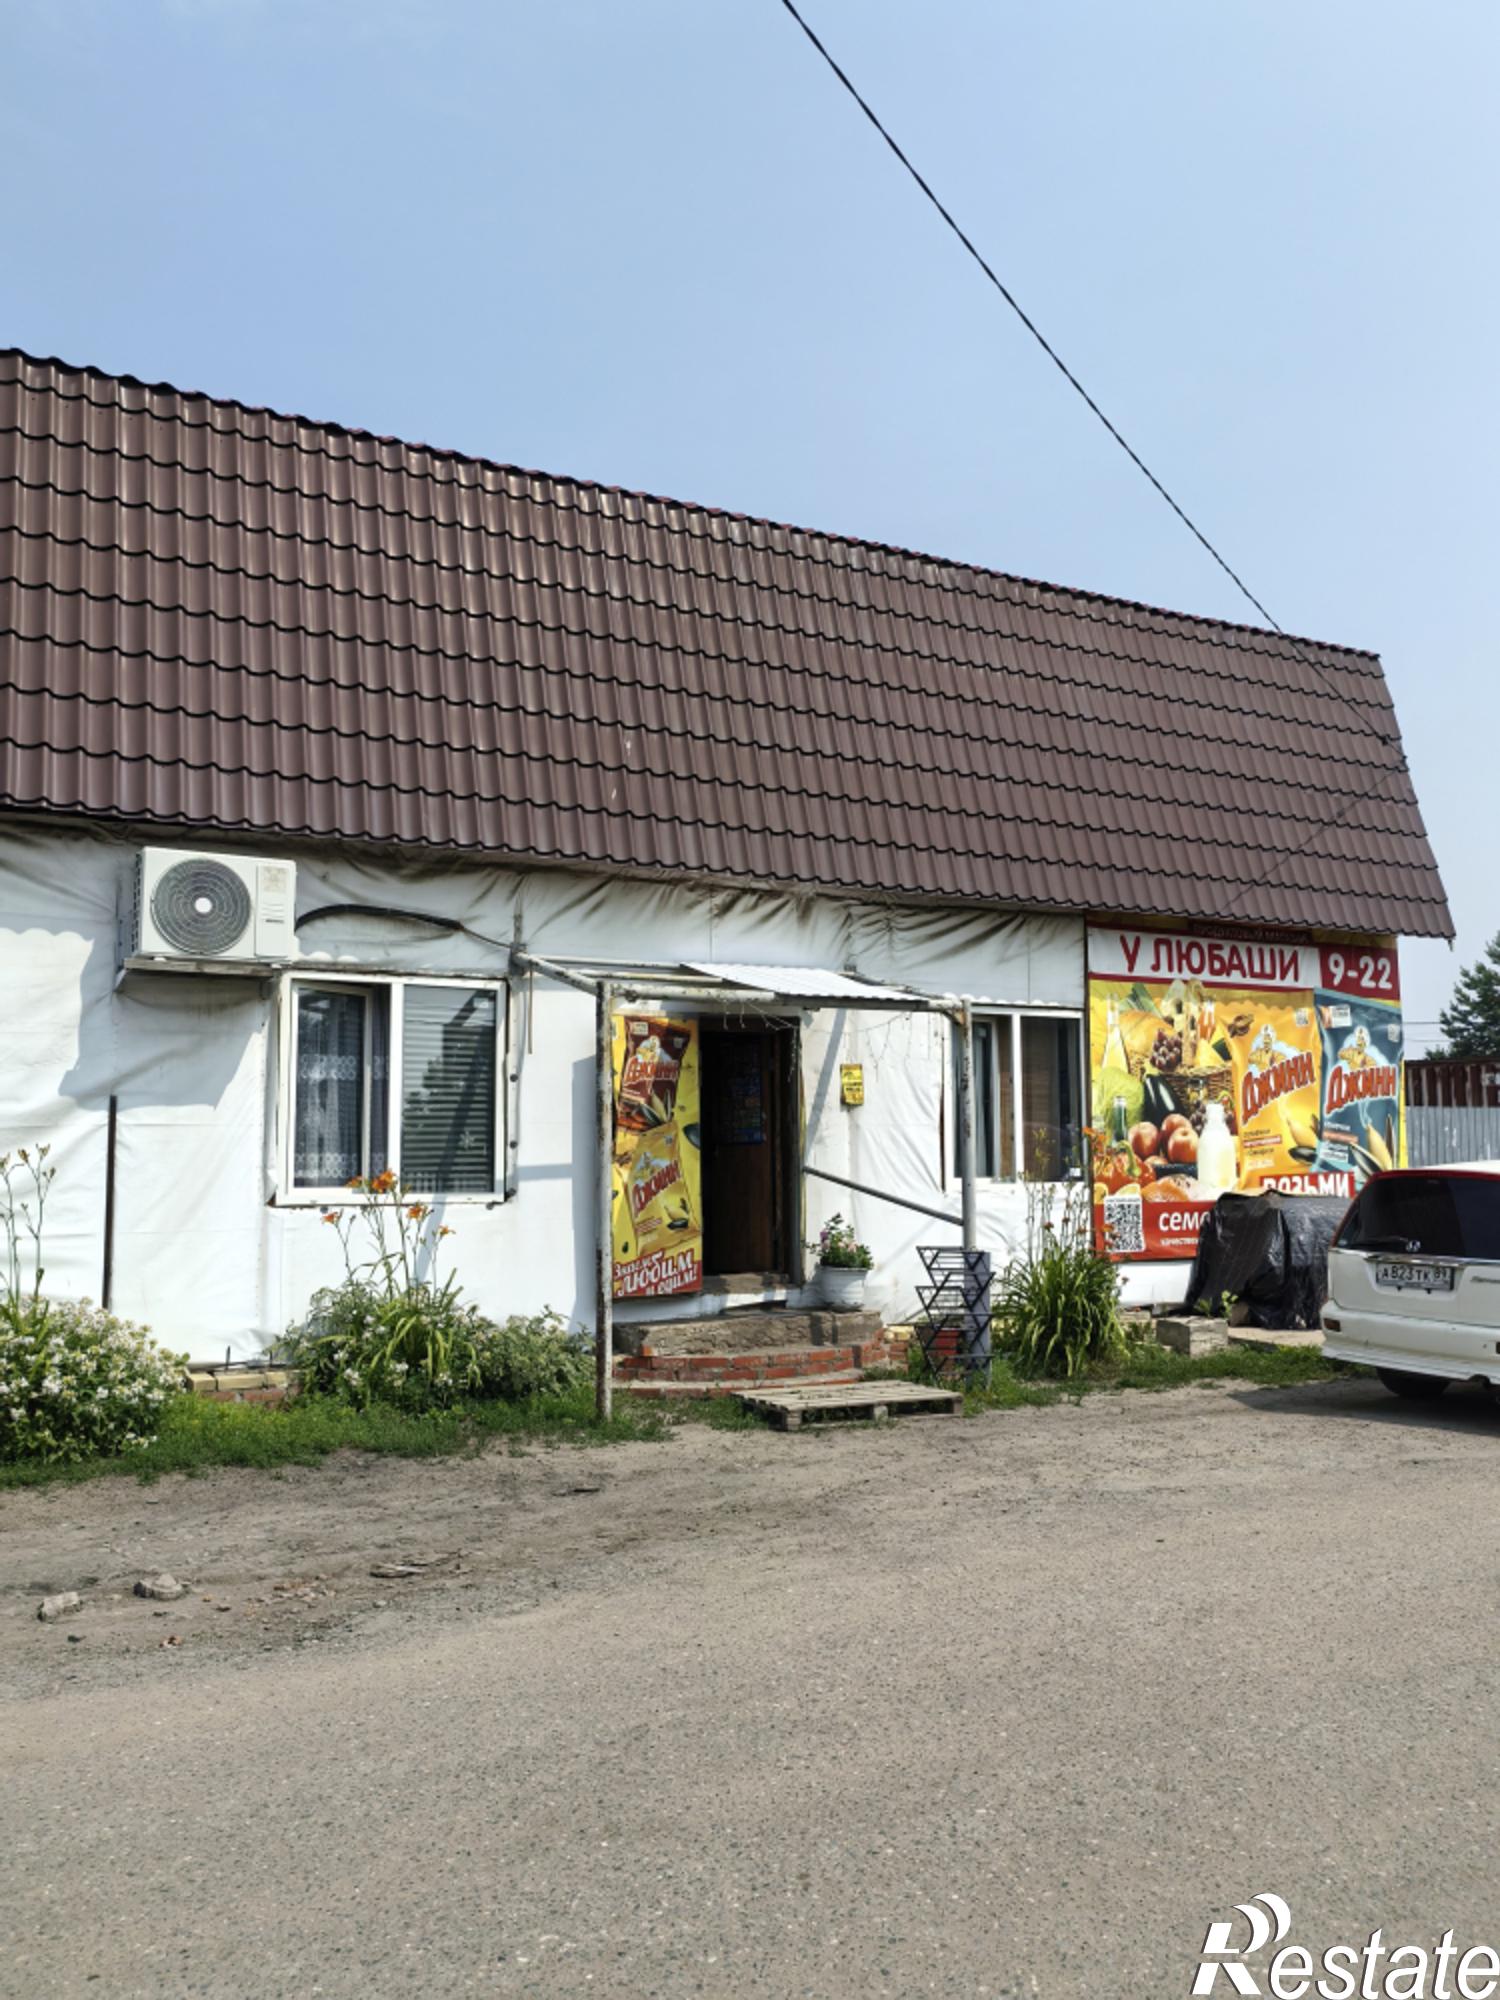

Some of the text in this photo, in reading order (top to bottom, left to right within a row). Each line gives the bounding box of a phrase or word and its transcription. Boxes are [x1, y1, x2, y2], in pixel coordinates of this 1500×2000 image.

[1119, 934, 1299, 982] У ЛЮБАШИ
[1328, 952, 1393, 990] 9-22
